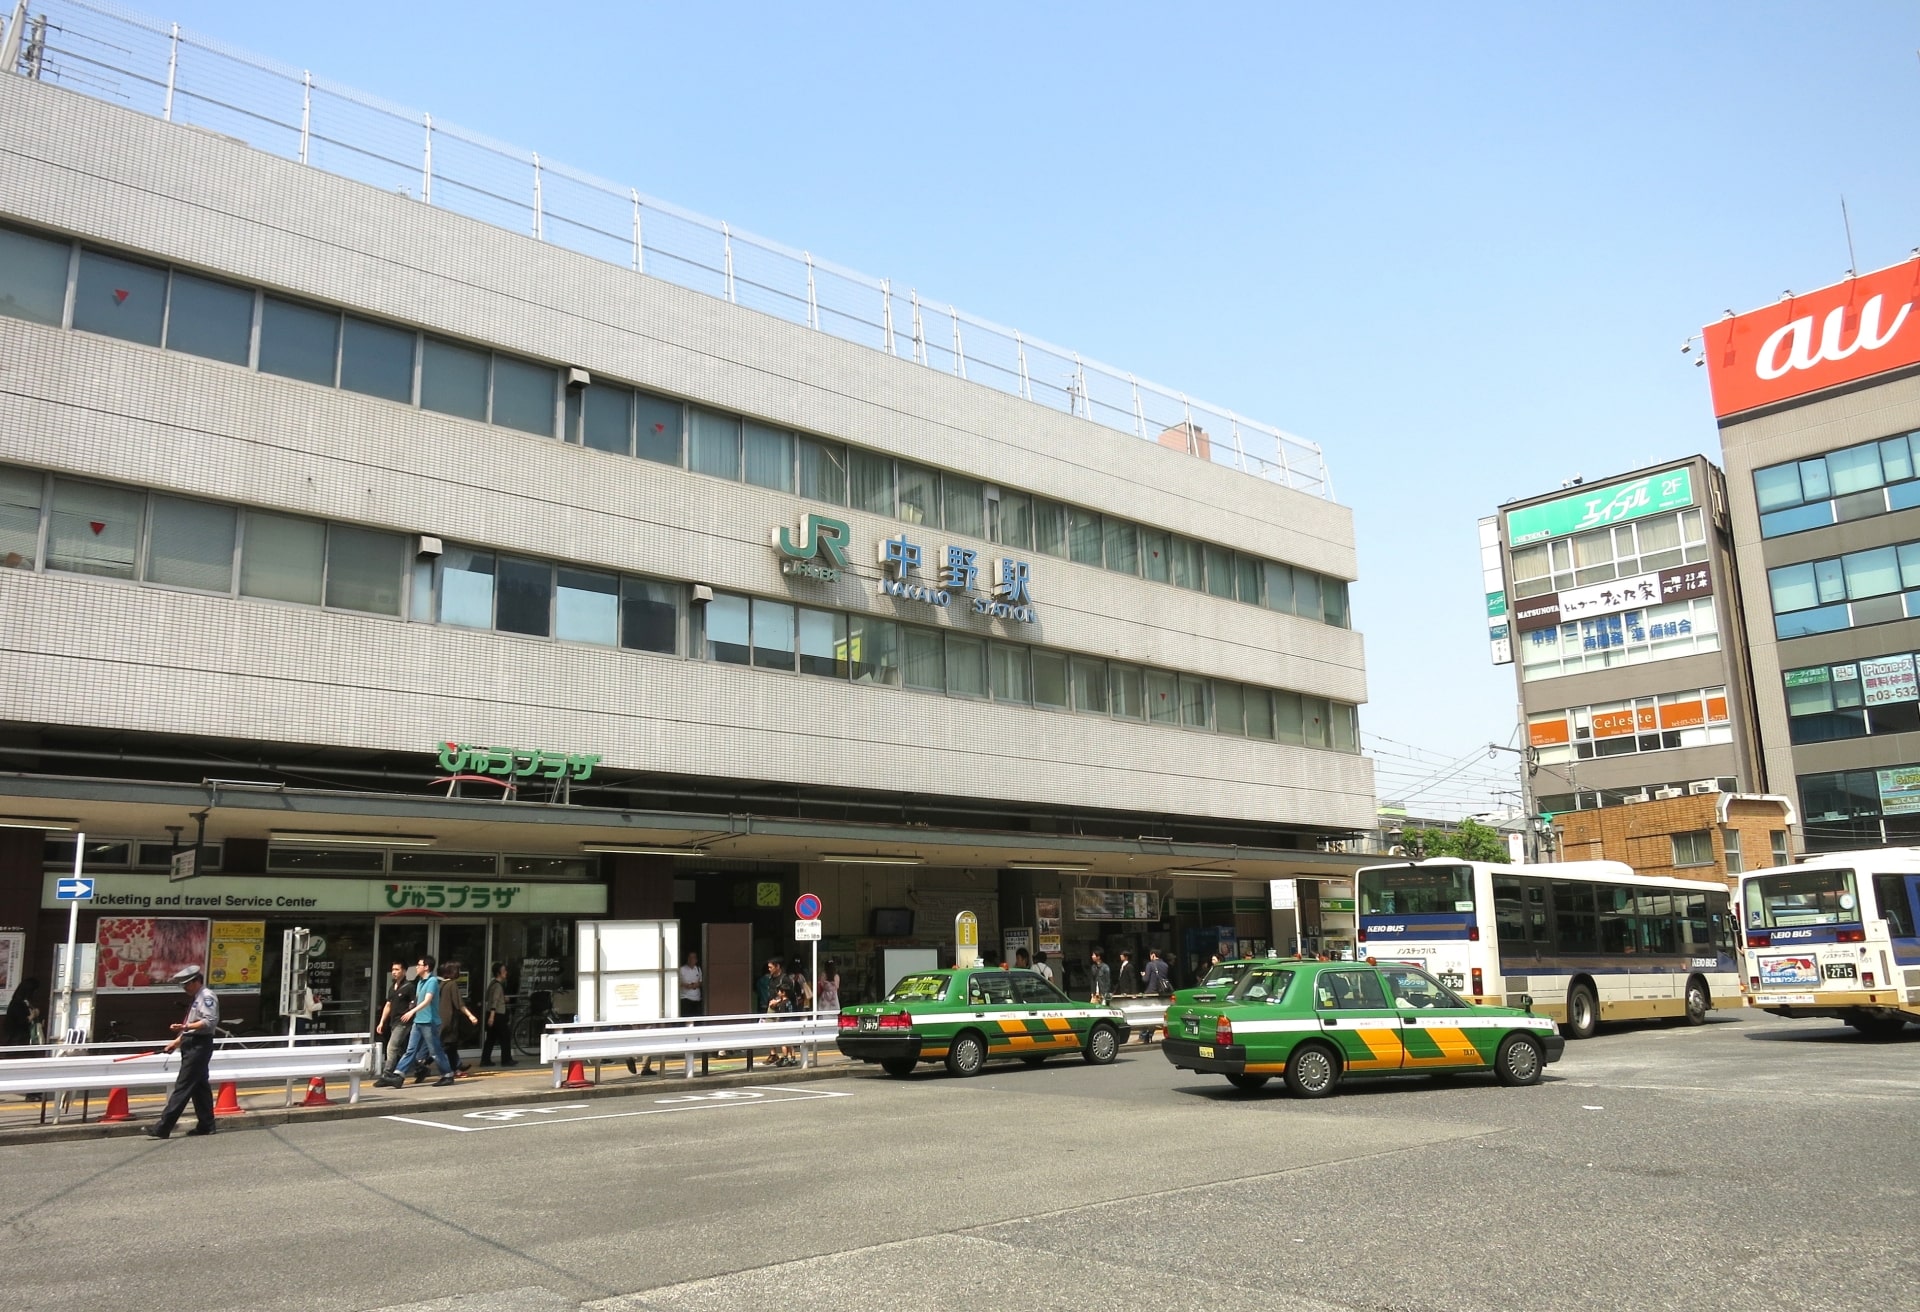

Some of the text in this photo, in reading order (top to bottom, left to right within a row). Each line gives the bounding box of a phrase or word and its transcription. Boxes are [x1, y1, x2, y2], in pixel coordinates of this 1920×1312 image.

[1756, 293, 1913, 381] au
[1661, 477, 1683, 496] 2F
[772, 513, 850, 568] JR
[878, 534, 1032, 605] 中野駅
[878, 578, 1035, 624] NAKANO STATION
[1600, 580, 1656, 606] 松乃家
[1517, 604, 1561, 620] MATSUNOYA
[1593, 713, 1652, 729] Celeste
[437, 740, 603, 781] びゅうプラザ
[155, 894, 180, 905] and
[185, 895, 221, 906] travel
[225, 896, 273, 907] Service
[276, 896, 317, 907] Center
[385, 885, 520, 908] びゅうプラザ
[1367, 924, 1405, 933] KEIO BUS
[1771, 930, 1813, 940] KEIO BUS
[1705, 958, 1717, 967] BUS
[1830, 967, 1854, 978] 27-15
